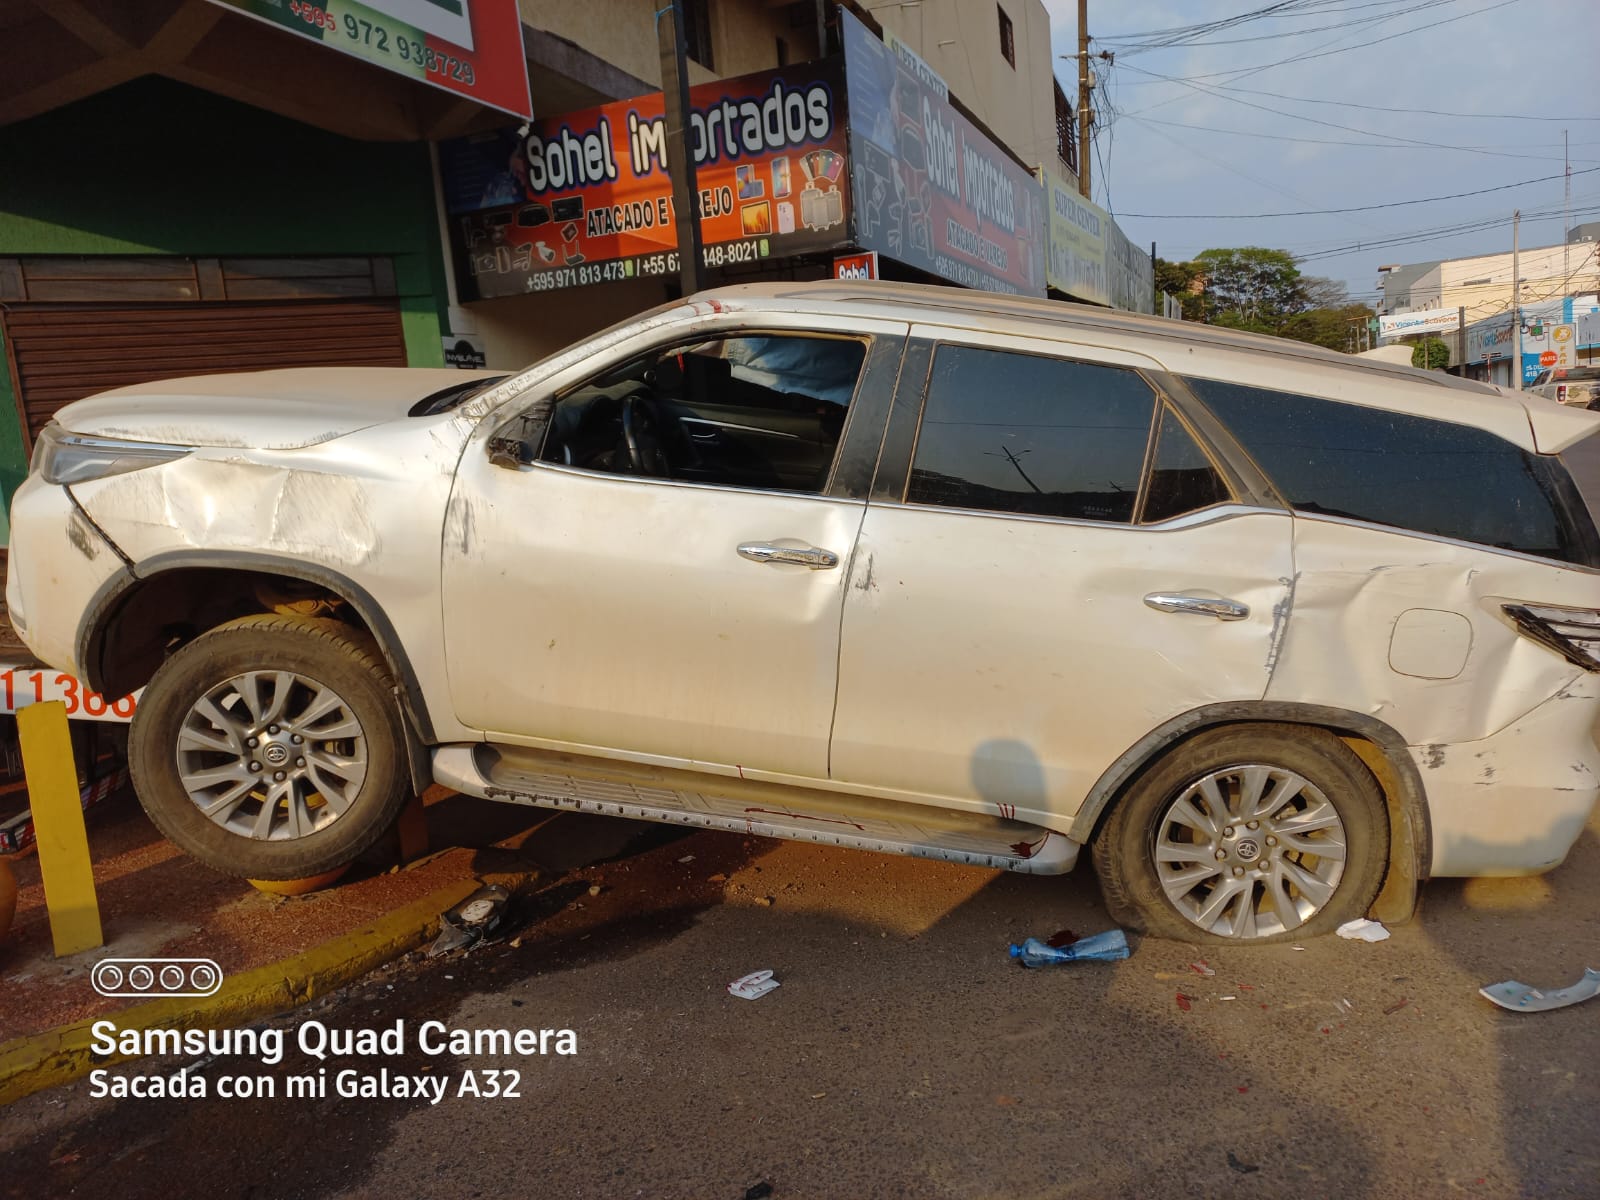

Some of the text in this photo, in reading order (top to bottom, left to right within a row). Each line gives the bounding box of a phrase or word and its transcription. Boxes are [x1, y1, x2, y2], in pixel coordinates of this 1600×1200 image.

[289, 1, 476, 87] +595 972 938729
[526, 118, 616, 192] Sohel
[629, 82, 830, 176] imortados
[923, 95, 961, 200] Sohel
[587, 199, 654, 238] ATACADO
[656, 197, 669, 226] E
[527, 271, 555, 291] +595
[556, 268, 577, 286] 971
[579, 264, 601, 285] 813
[603, 260, 625, 281] 473
[642, 255, 666, 275] +55
